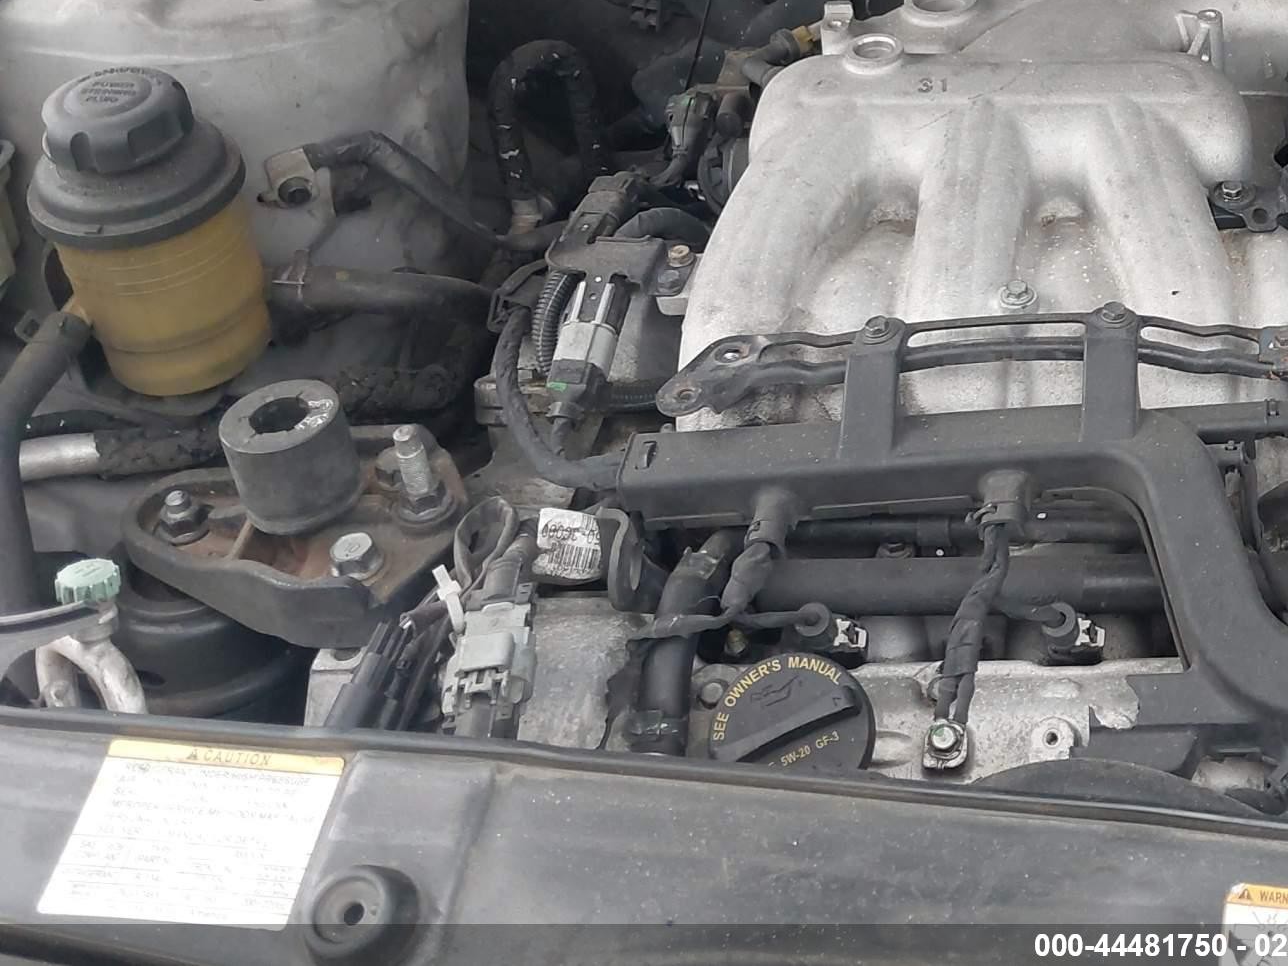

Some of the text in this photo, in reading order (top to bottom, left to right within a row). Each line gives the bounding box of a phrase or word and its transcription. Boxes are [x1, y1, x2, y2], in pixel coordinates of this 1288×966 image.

[713, 656, 843, 740] SEE OWNER'S MANUAL
[203, 750, 273, 766] CAUTION
[780, 730, 841, 767] 5W-20 GF-3
